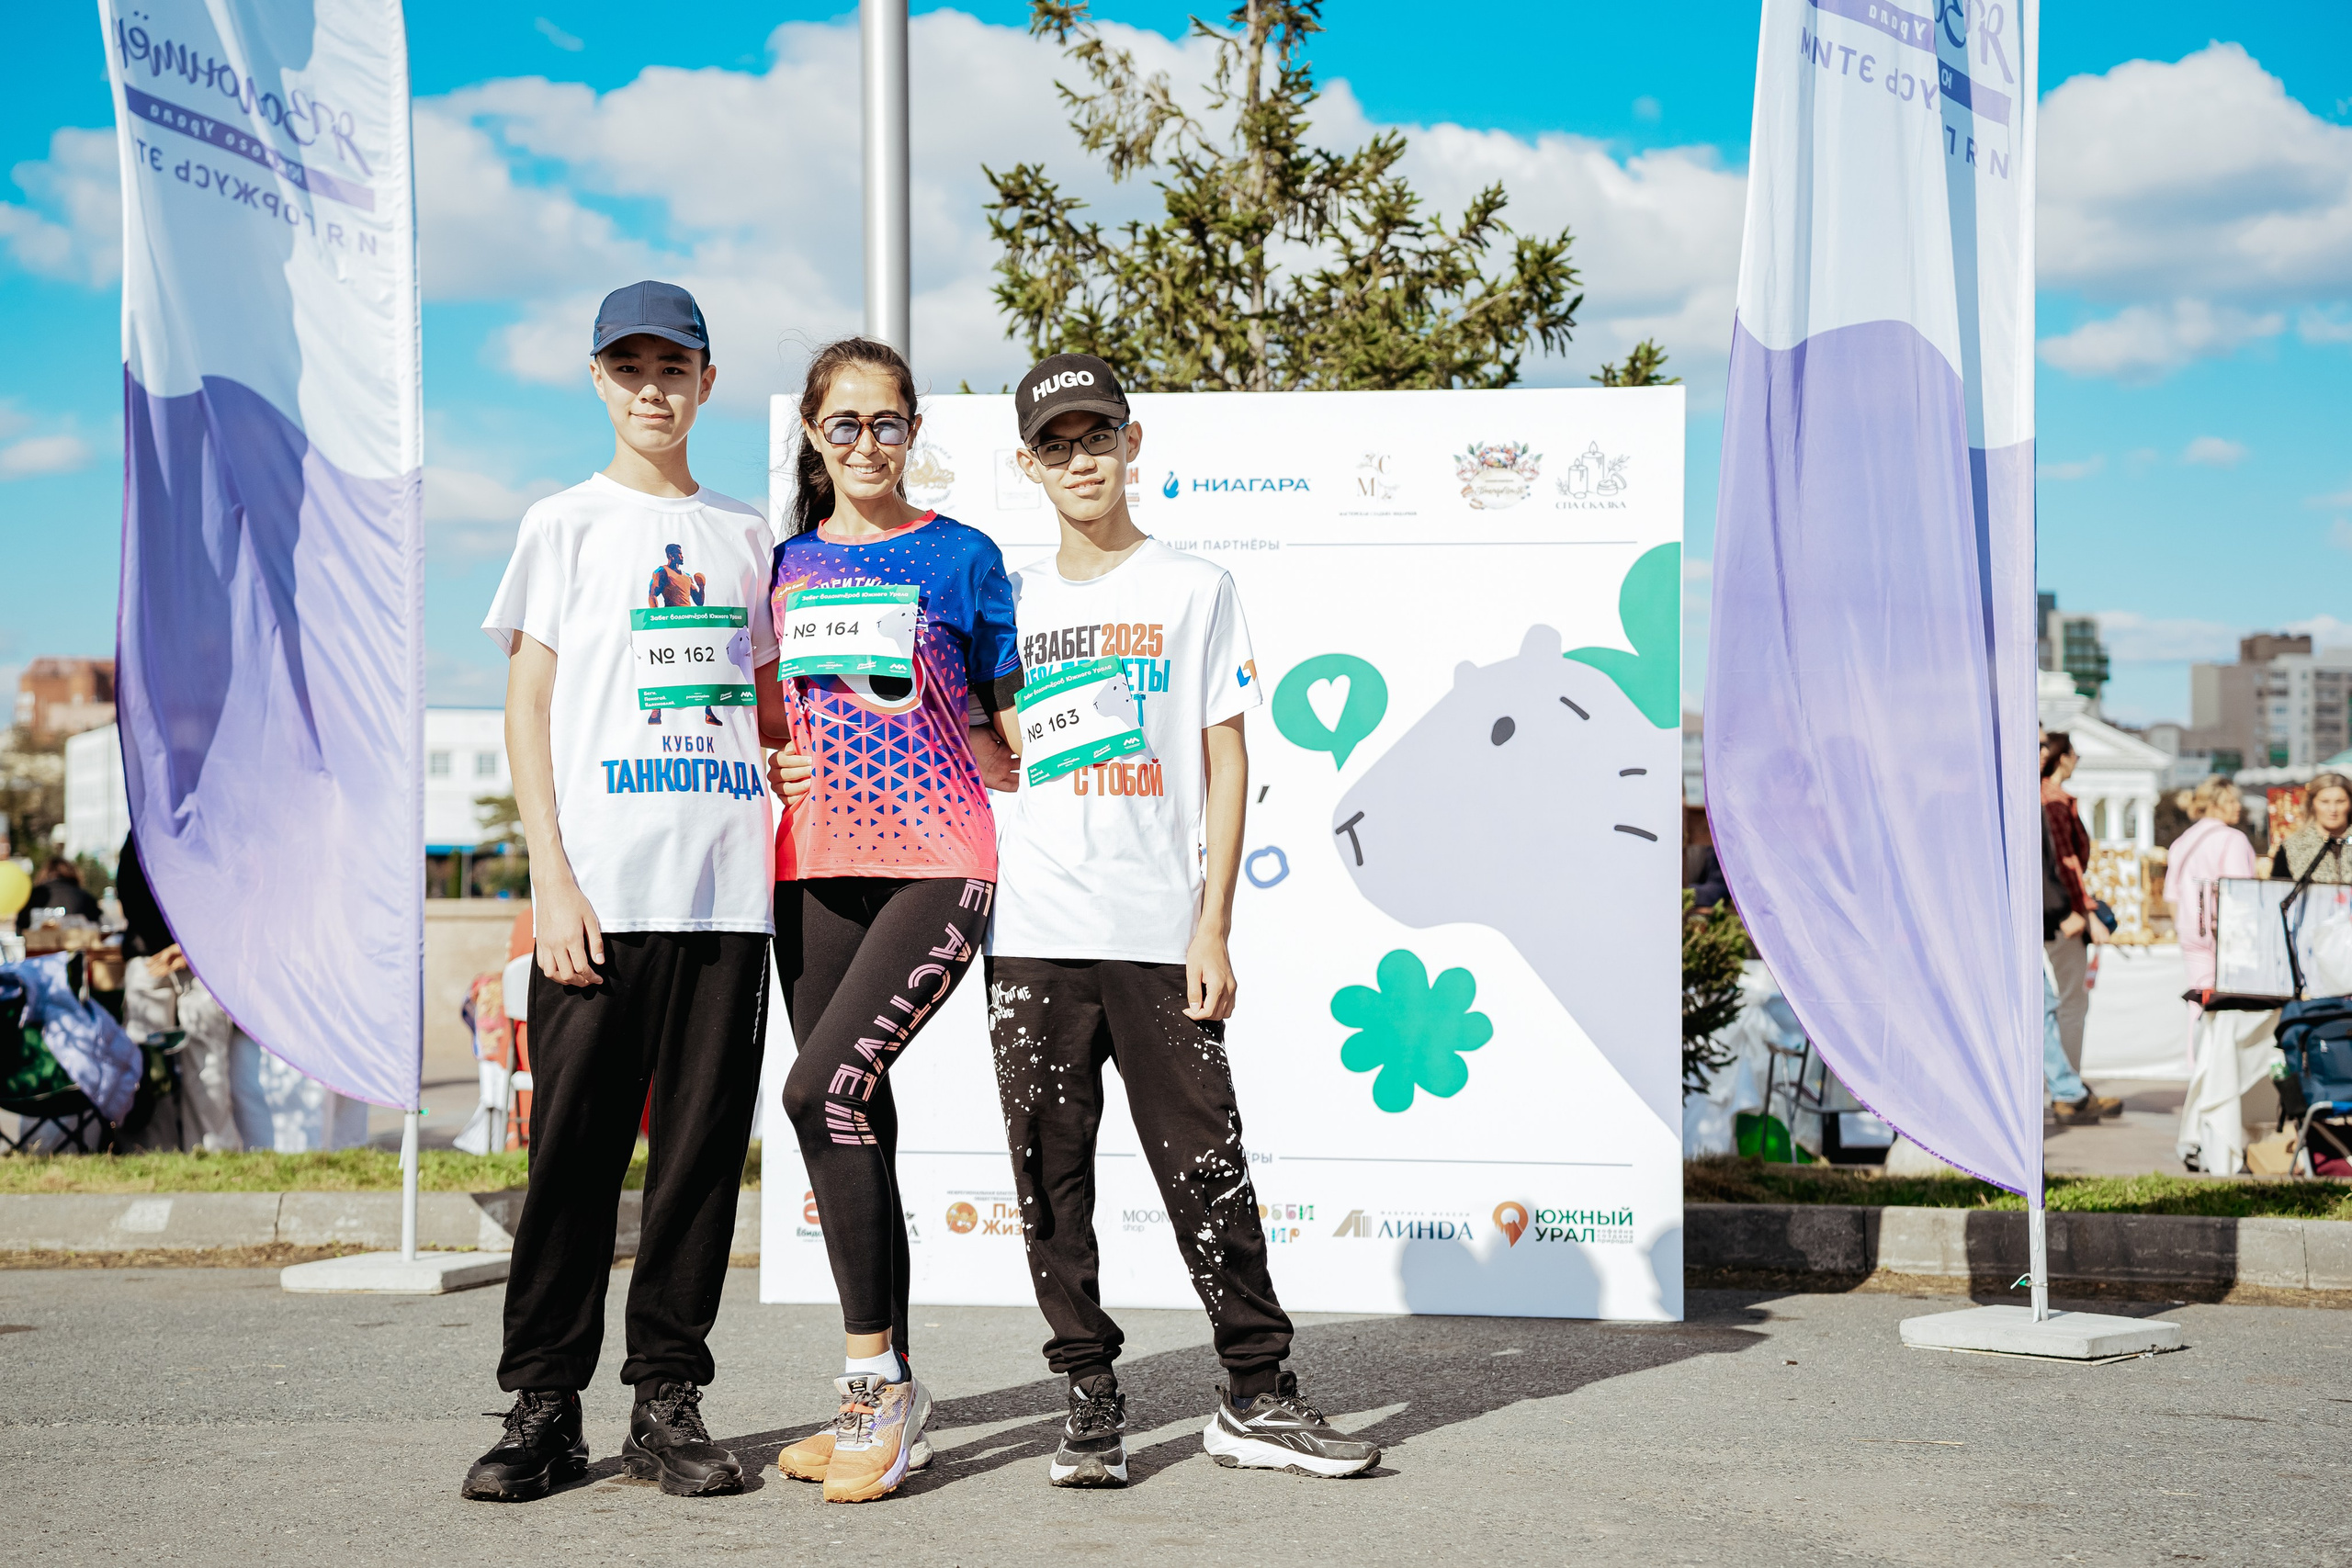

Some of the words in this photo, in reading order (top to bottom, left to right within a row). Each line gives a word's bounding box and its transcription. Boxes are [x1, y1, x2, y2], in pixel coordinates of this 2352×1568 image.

[1032, 370, 1095, 402] HUGO
[1193, 477, 1310, 492] НИАГАРА
[1203, 537, 1280, 550] ПАРТНЁРЫ
[826, 621, 860, 636] 164
[684, 646, 716, 663] 162
[1092, 663, 1113, 674] Урала
[1048, 708, 1080, 733] 163
[662, 735, 715, 753] КУБОК
[601, 758, 765, 801] ТАНКОГРАДА
[1073, 766, 1089, 796] С
[1092, 758, 1164, 797] ТОБОЙ
[827, 921, 972, 1102] ACTIVE
[1535, 1206, 1634, 1226] ЮЖНЫЙ
[1123, 1224, 1145, 1233] shop
[1534, 1227, 1596, 1243] УРАЛ
